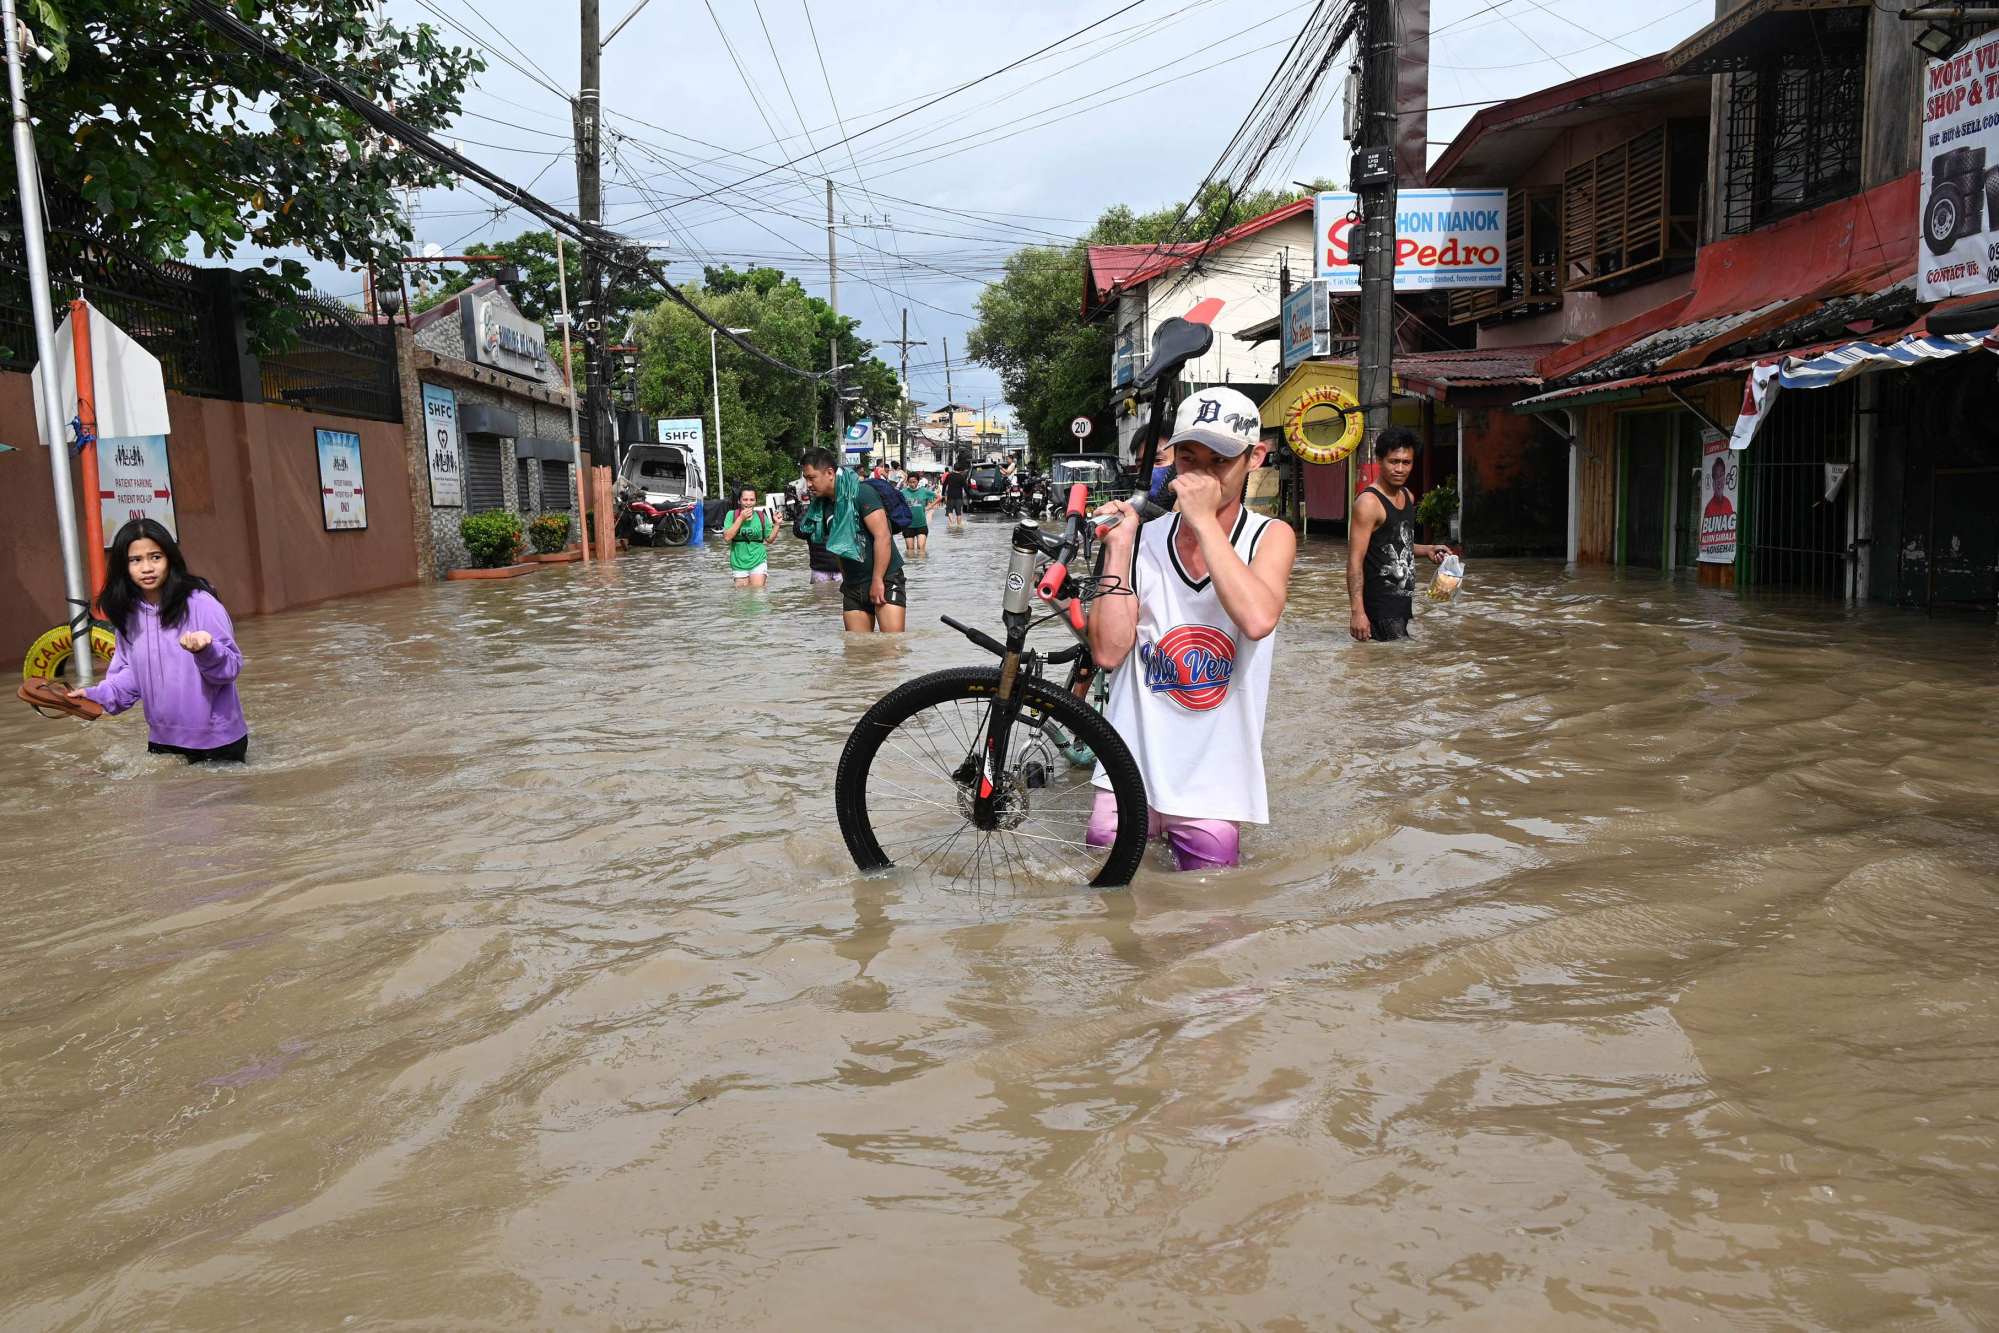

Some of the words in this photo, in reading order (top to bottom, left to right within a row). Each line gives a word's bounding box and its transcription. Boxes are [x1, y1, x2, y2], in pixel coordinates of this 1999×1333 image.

[1927, 85, 1966, 122] SHOP
[1967, 79, 1982, 106] &
[1437, 209, 1499, 232] MANOK
[1395, 237, 1500, 267] Pedro
[1926, 264, 1965, 285] CONTACT
[428, 402, 452, 418] SHFC
[1192, 398, 1221, 426] D
[665, 431, 697, 440] SHFC
[115, 478, 134, 488] PATIENT
[118, 494, 135, 504] PATIENT
[1703, 514, 1736, 533] BUNAG
